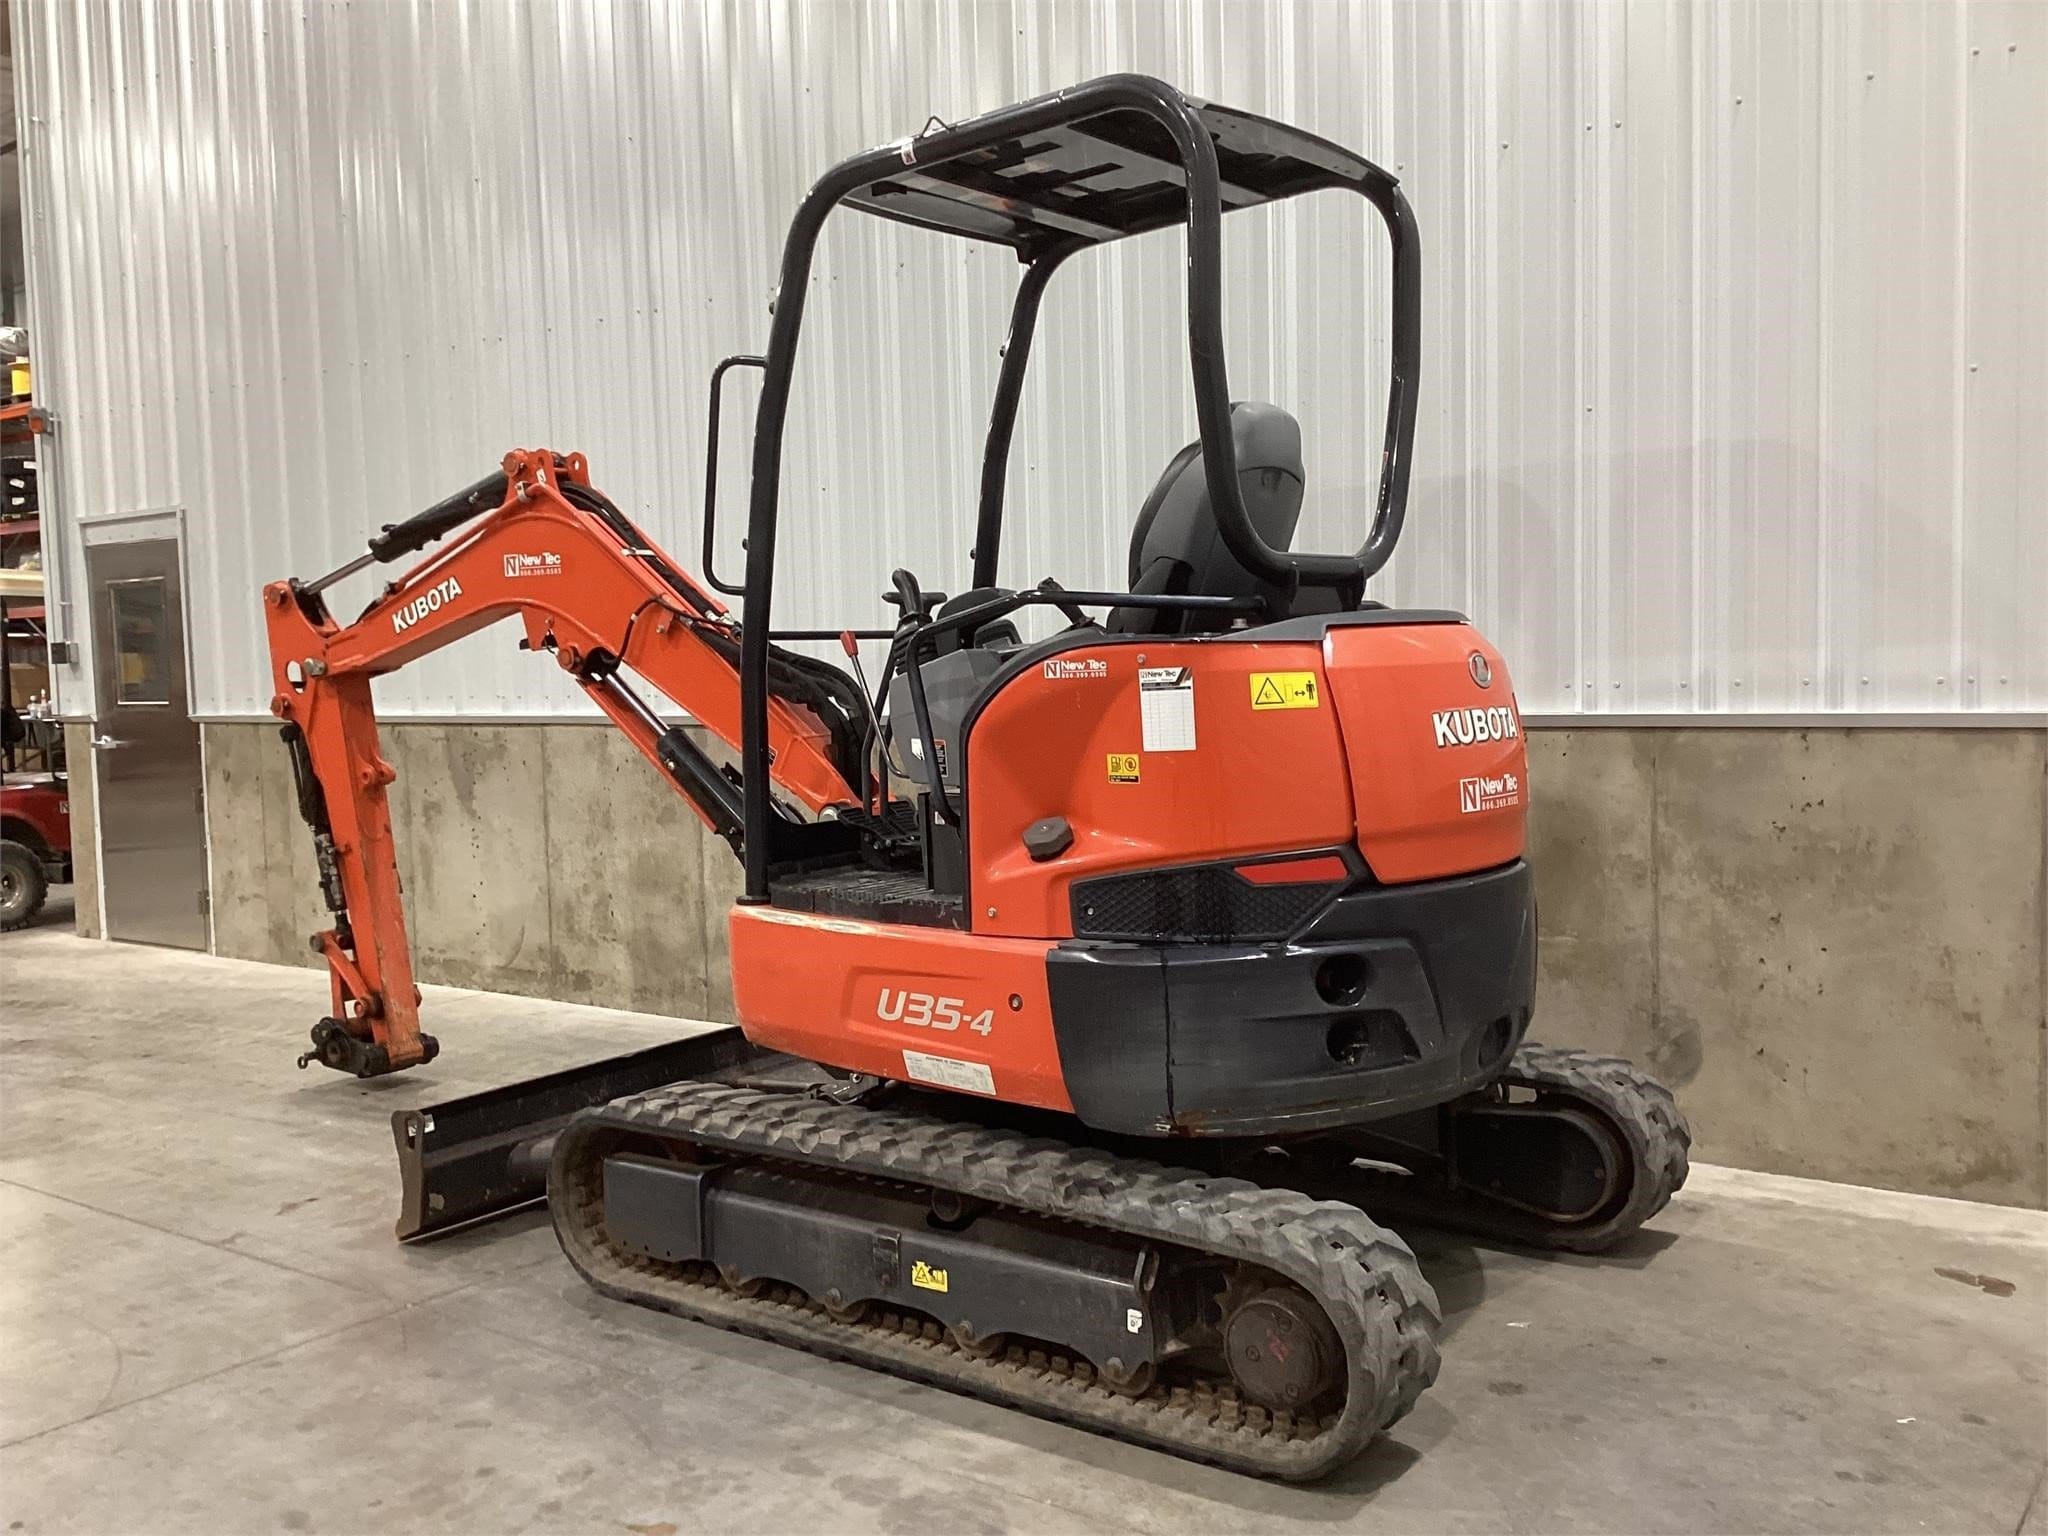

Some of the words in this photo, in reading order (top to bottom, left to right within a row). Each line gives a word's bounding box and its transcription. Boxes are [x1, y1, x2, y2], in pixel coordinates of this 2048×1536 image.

[520, 554, 541, 566] New
[542, 552, 561, 564] Tec
[391, 576, 463, 633] KUBOTA
[1060, 660, 1085, 670] New
[1087, 659, 1107, 669] Tec
[1432, 706, 1518, 747] KUBOTA
[1480, 776, 1504, 796] New
[1503, 773, 1518, 792] Tec
[877, 988, 994, 1036] U35-4
